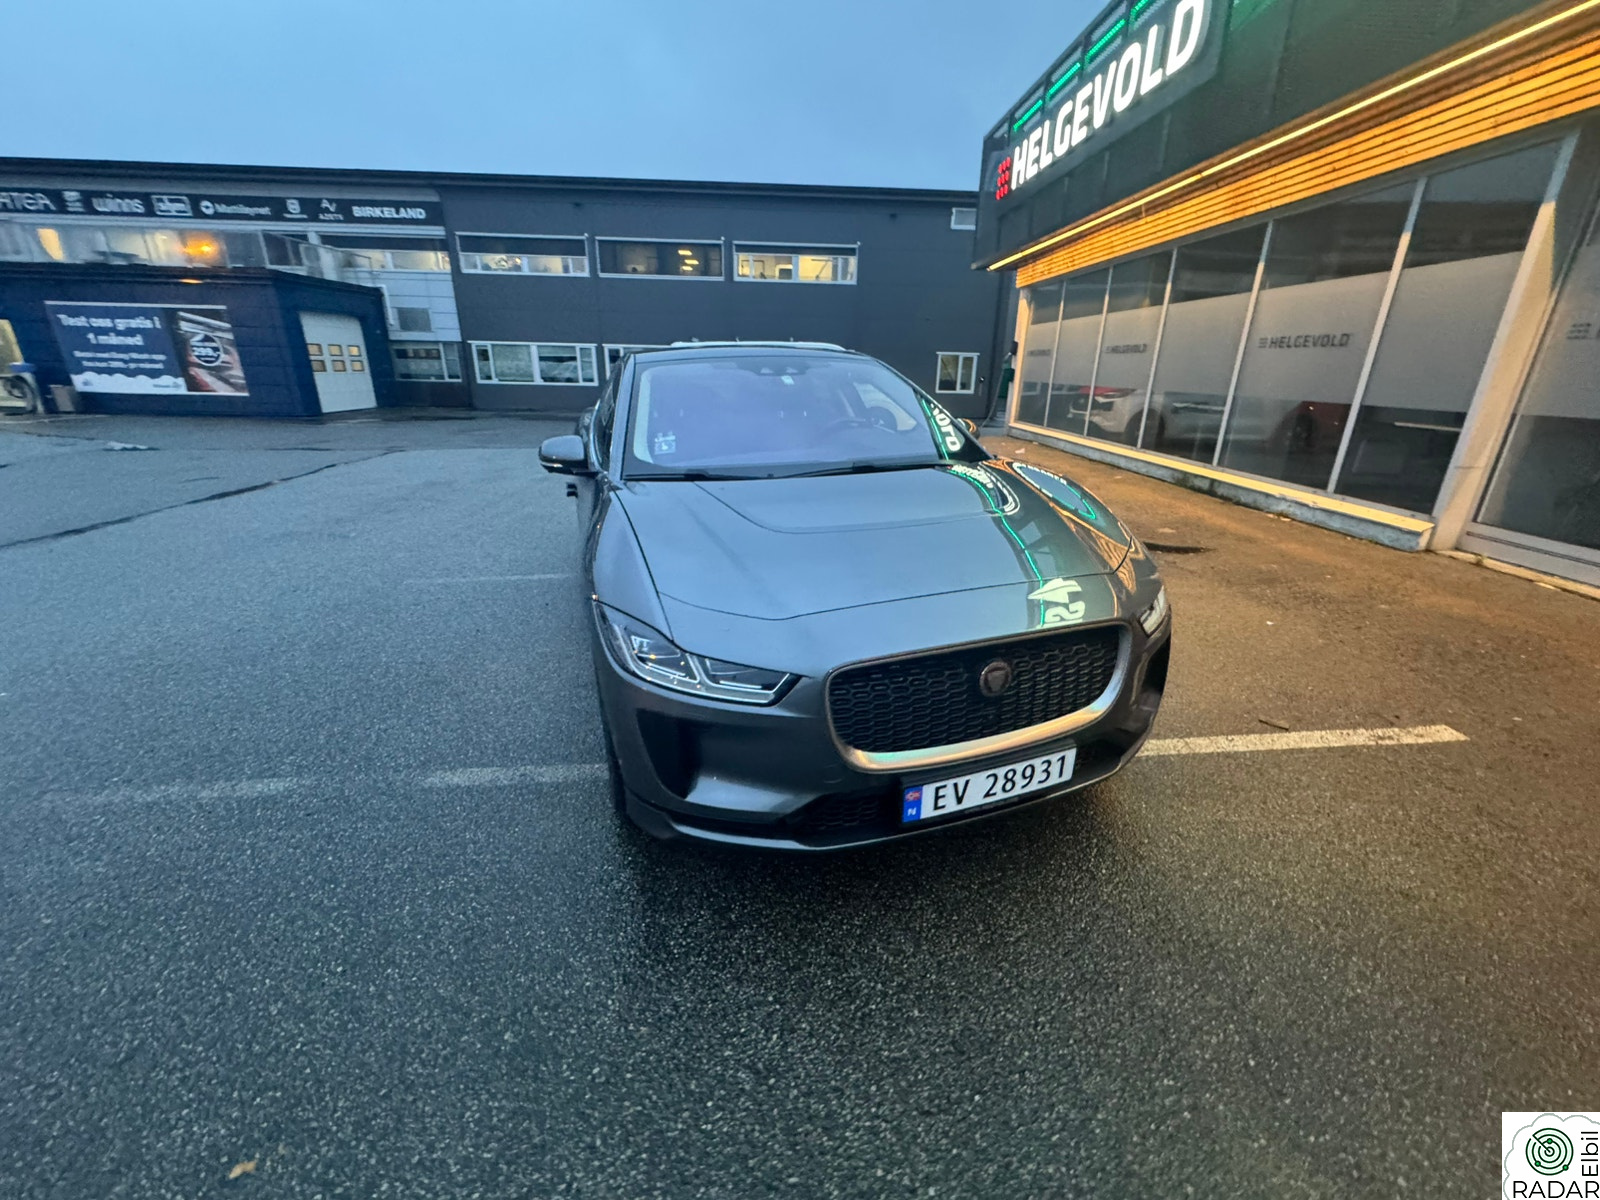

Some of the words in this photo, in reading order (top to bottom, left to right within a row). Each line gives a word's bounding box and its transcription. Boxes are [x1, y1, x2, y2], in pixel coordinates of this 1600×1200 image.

[1011, 0, 1204, 190] HELGEVOLD
[352, 205, 427, 219] BIRKELAND
[1268, 333, 1352, 349] HELGEVOLD
[933, 779, 970, 811] EV
[983, 755, 1067, 799] 28931
